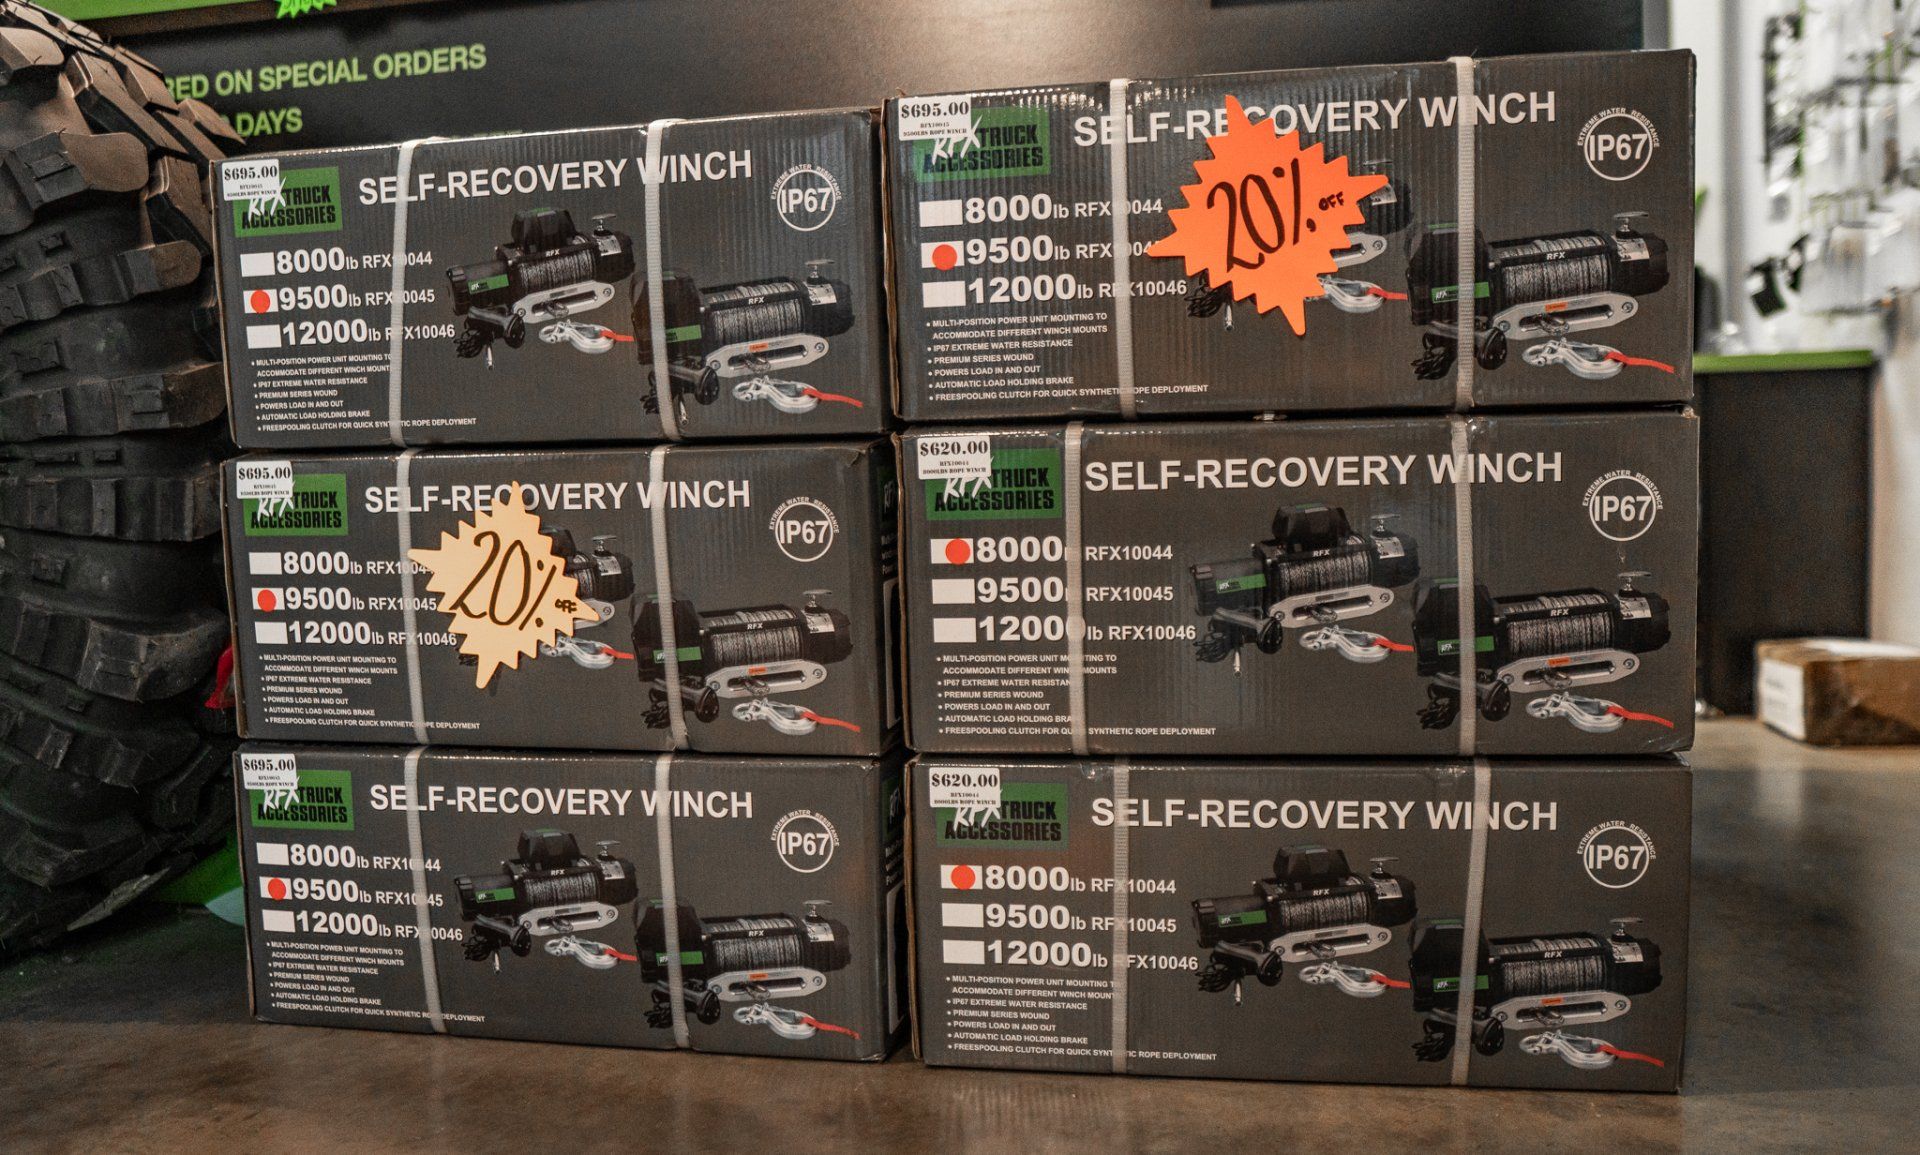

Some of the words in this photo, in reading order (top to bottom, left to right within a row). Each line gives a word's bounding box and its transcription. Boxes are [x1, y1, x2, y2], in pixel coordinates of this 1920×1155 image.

[215, 69, 253, 96] ON
[259, 57, 367, 92] SPECIAL
[373, 43, 487, 79] ORDERS
[901, 101, 968, 118] $695.00
[1419, 91, 1556, 128] WNCH
[236, 107, 303, 137] DAYS
[1577, 115, 1599, 146] EXTREME
[1599, 107, 1626, 117] WATER
[980, 124, 1038, 147] TRUCK
[1589, 133, 1648, 161] IP67
[224, 165, 278, 180] $695.00
[923, 147, 1043, 174] ACCESSORIES
[771, 171, 789, 200] EXTREME
[789, 164, 812, 173] WATER
[284, 185, 331, 206] TRUCK
[781, 187, 832, 214] IP67
[1319, 191, 1344, 211] OFF
[241, 205, 336, 229] ACCESSORIES
[965, 193, 1068, 224] 8000lb
[1075, 199, 1163, 217] RFX0044
[1207, 157, 1316, 273] 20%
[276, 247, 358, 274] 8000lb
[363, 252, 432, 268] RFX0044
[966, 235, 1069, 265] 9500lb
[1546, 251, 1565, 260] RFX
[279, 284, 361, 311] 9500lb
[366, 289, 435, 305] RFX0045
[748, 296, 765, 304] RFX
[968, 273, 1092, 304] 12000lb
[1100, 280, 1187, 298] RX10046
[282, 318, 381, 346] 12000lb
[386, 324, 455, 341] RX10046
[932, 318, 996, 327] MULTI-POSITION
[998, 316, 1028, 325] POWER
[1050, 314, 1093, 323] MOUNTING
[1097, 313, 1107, 321] TO
[933, 330, 996, 340] ACCOMMODATE
[998, 328, 1041, 337] DIFFERENT
[1043, 327, 1073, 335] WINCH
[1075, 325, 1107, 334] MOUNTS
[933, 344, 949, 352] IP67
[952, 343, 989, 351] EXTREME
[992, 341, 1020, 350] WATER
[1022, 340, 1072, 348] RESISTANCE
[934, 356, 970, 364] PREMIUM
[973, 355, 1001, 363] SERIES
[1003, 354, 1034, 362] WOUND
[935, 369, 969, 377] POWERS
[935, 380, 981, 389] AUTOMATIC
[1007, 378, 1044, 386] HOLDING
[1046, 377, 1075, 385] BRAKE
[936, 392, 997, 402] FREESPOOLING
[999, 391, 1031, 399] CLUTCH
[1033, 390, 1049, 398] FOR
[1052, 389, 1077, 397] QUICK
[1127, 386, 1150, 394] OPE
[1152, 384, 1208, 393] DEPLOYMENT
[920, 441, 988, 456] $620.00
[238, 466, 291, 480] $695.00
[991, 468, 1049, 488] TRUCK
[1085, 456, 1415, 492] SELF-RECOVERY
[1428, 452, 1562, 483] WINCH
[293, 491, 337, 509] TRUCK
[1582, 477, 1604, 506] EXTREME
[1605, 470, 1631, 479] WATER
[769, 503, 787, 530] EXTREME
[787, 496, 810, 505] WATER
[934, 490, 1054, 512] ACCESSORIES
[1594, 496, 1652, 521] IP67
[250, 511, 342, 529] ACCESSORIES
[779, 520, 830, 544] IP67
[282, 551, 362, 576] 8000lb
[1086, 546, 1173, 560] RFX10044
[449, 531, 557, 631] 20%
[285, 586, 365, 611] 9500lb
[1086, 587, 1173, 601] RFX10045
[1550, 608, 1569, 616] RFX
[288, 621, 384, 646] 12000lb
[1109, 626, 1196, 640] RFX10046
[244, 759, 294, 771] $695.00
[931, 773, 998, 787] $620.00
[298, 786, 343, 804] TRUCK
[256, 803, 348, 823] ACCESSORIES
[1000, 802, 1057, 820] TRUCK
[1091, 798, 1414, 829] SELF-RECOVERY
[771, 815, 789, 841] EXTREME
[944, 822, 1062, 841] ACCESSORIES
[1577, 826, 1599, 855] EXTREME
[1599, 820, 1625, 829] WATER
[781, 832, 831, 856] IP67
[290, 843, 369, 870] 8000lb
[1588, 844, 1645, 871] IP67
[292, 877, 372, 904] 9500lb
[986, 865, 1085, 893] 8000lb
[1092, 878, 1176, 893] RF10044
[296, 910, 391, 938] 12000lb
[396, 925, 463, 941] RFX0046
[986, 903, 1085, 931] 9500lb
[1092, 916, 1176, 933] RF10045
[748, 929, 764, 937] RFX
[987, 939, 1107, 969] 12000lb
[1114, 954, 1198, 971] FX10046
[1544, 950, 1563, 958] RFX
